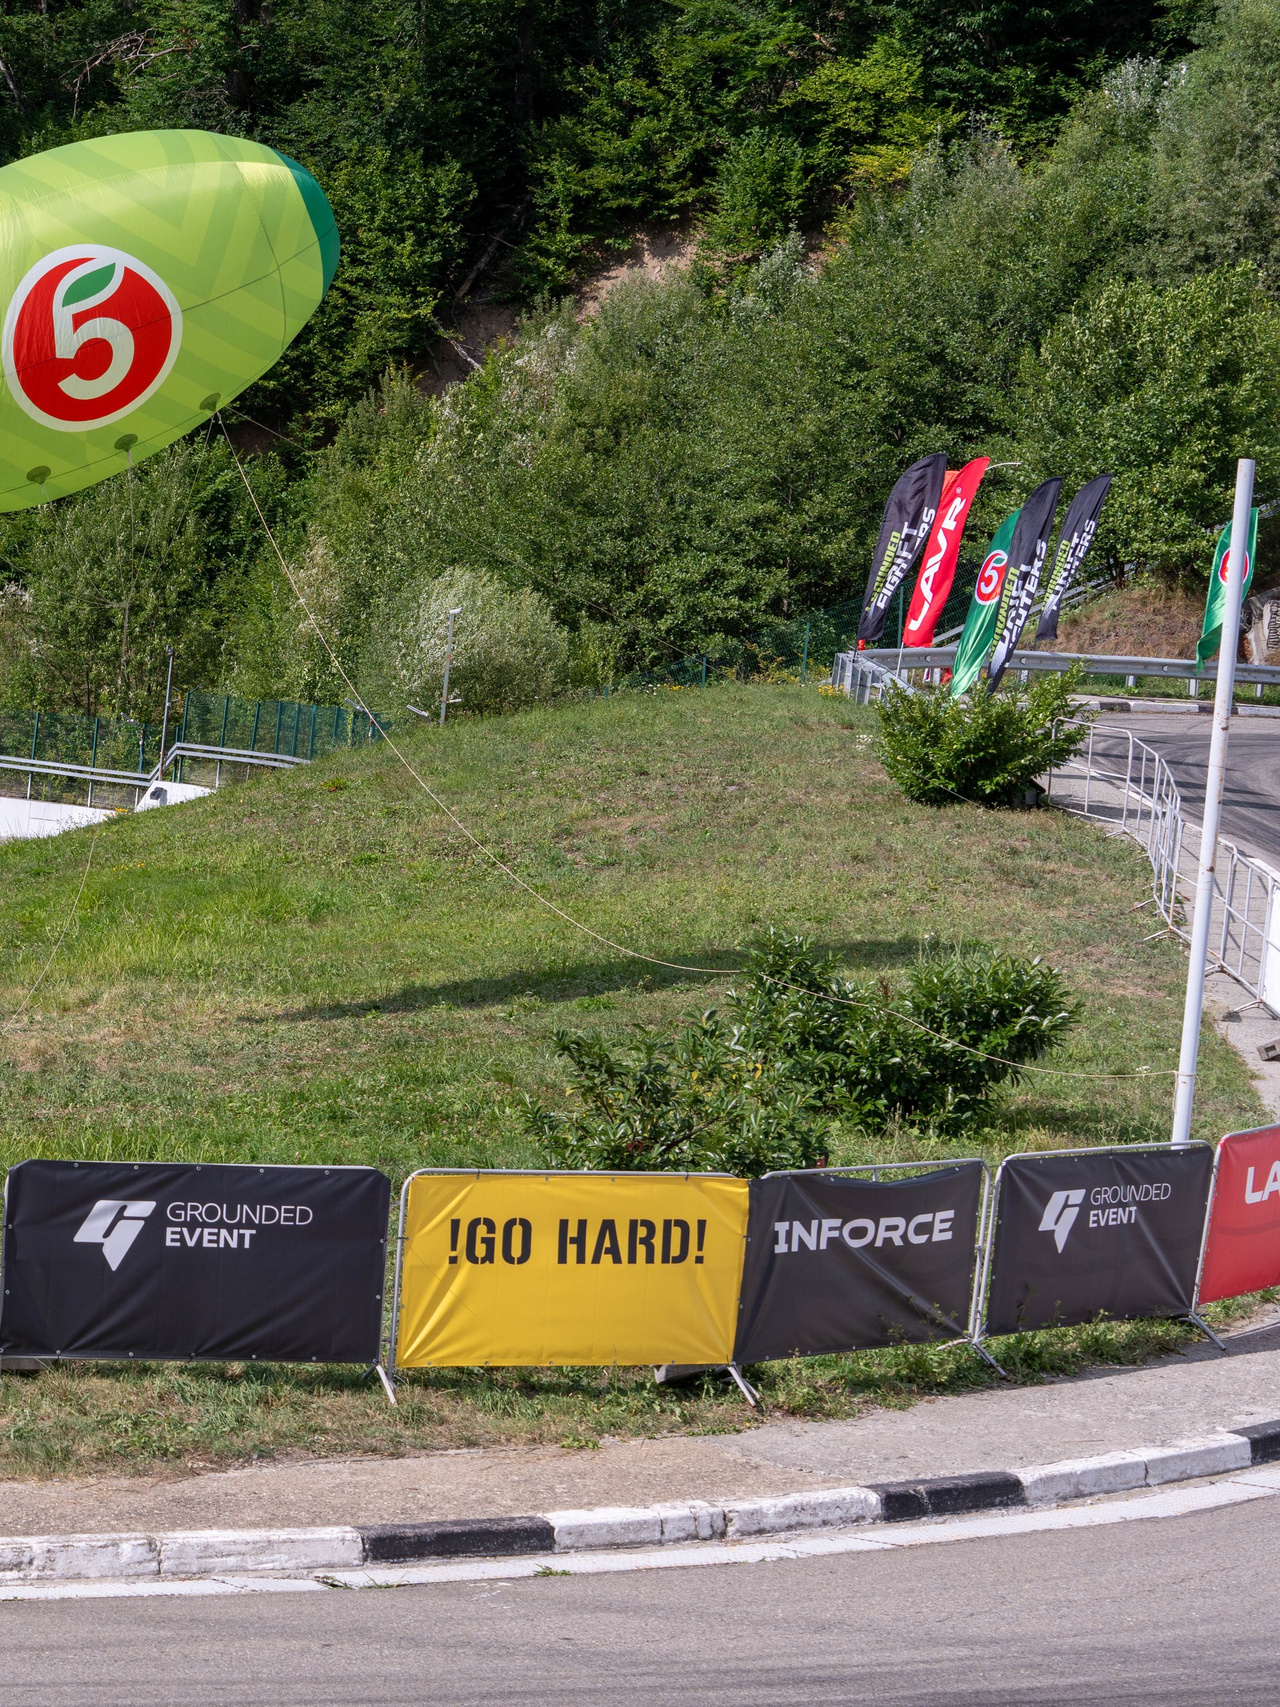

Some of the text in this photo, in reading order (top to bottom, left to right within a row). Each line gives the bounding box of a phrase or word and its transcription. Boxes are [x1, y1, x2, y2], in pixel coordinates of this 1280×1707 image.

[1090, 1183, 1171, 1205] GROUNDED
[166, 1202, 313, 1225] GROUNDED
[1088, 1206, 1137, 1228] EVENT
[165, 1227, 256, 1248] EVENT
[448, 1217, 707, 1265] !GO HARD!
[774, 1209, 955, 1254] INFORCE
